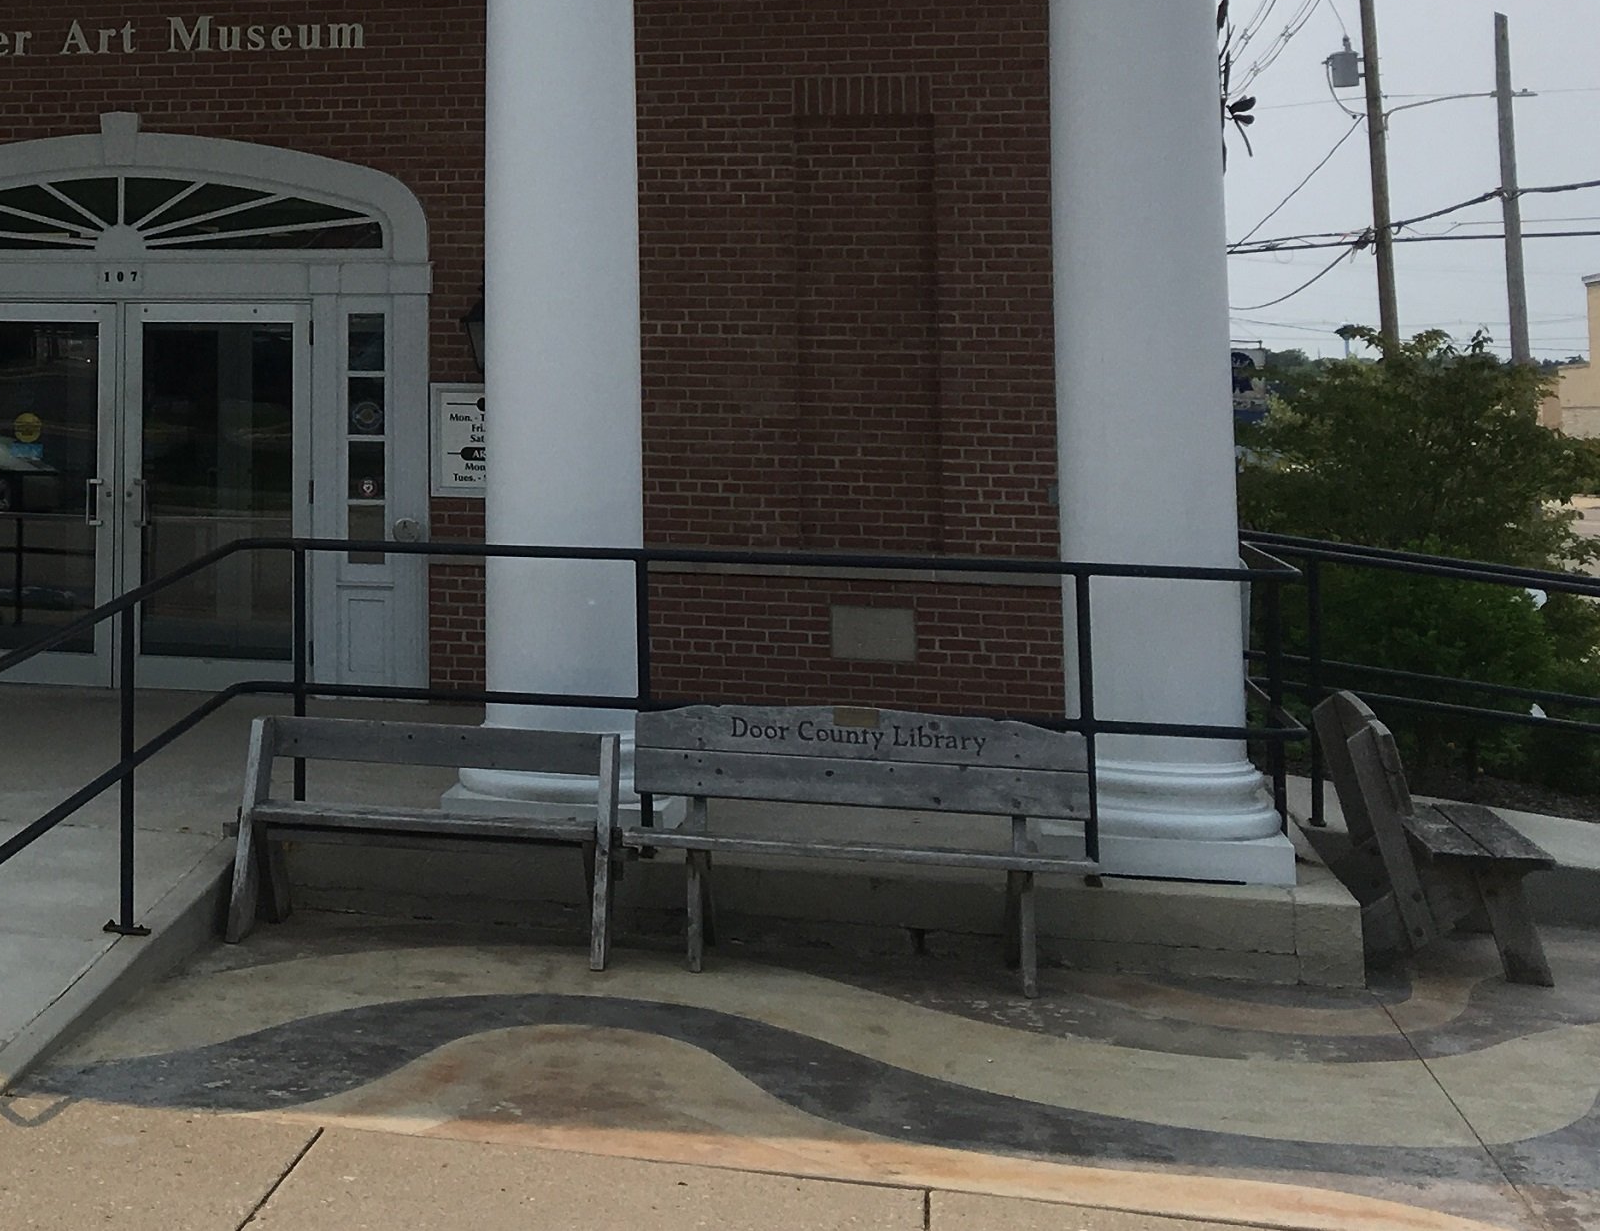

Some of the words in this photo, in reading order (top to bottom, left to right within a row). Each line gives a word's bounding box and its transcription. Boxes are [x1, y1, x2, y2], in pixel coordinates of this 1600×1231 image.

[60, 19, 138, 55] Art
[166, 15, 366, 53] Museum
[449, 413, 472, 422] Mon.
[453, 473, 477, 482] Tues.
[731, 717, 790, 741] Door
[798, 720, 884, 751] County
[892, 725, 986, 756] Library
